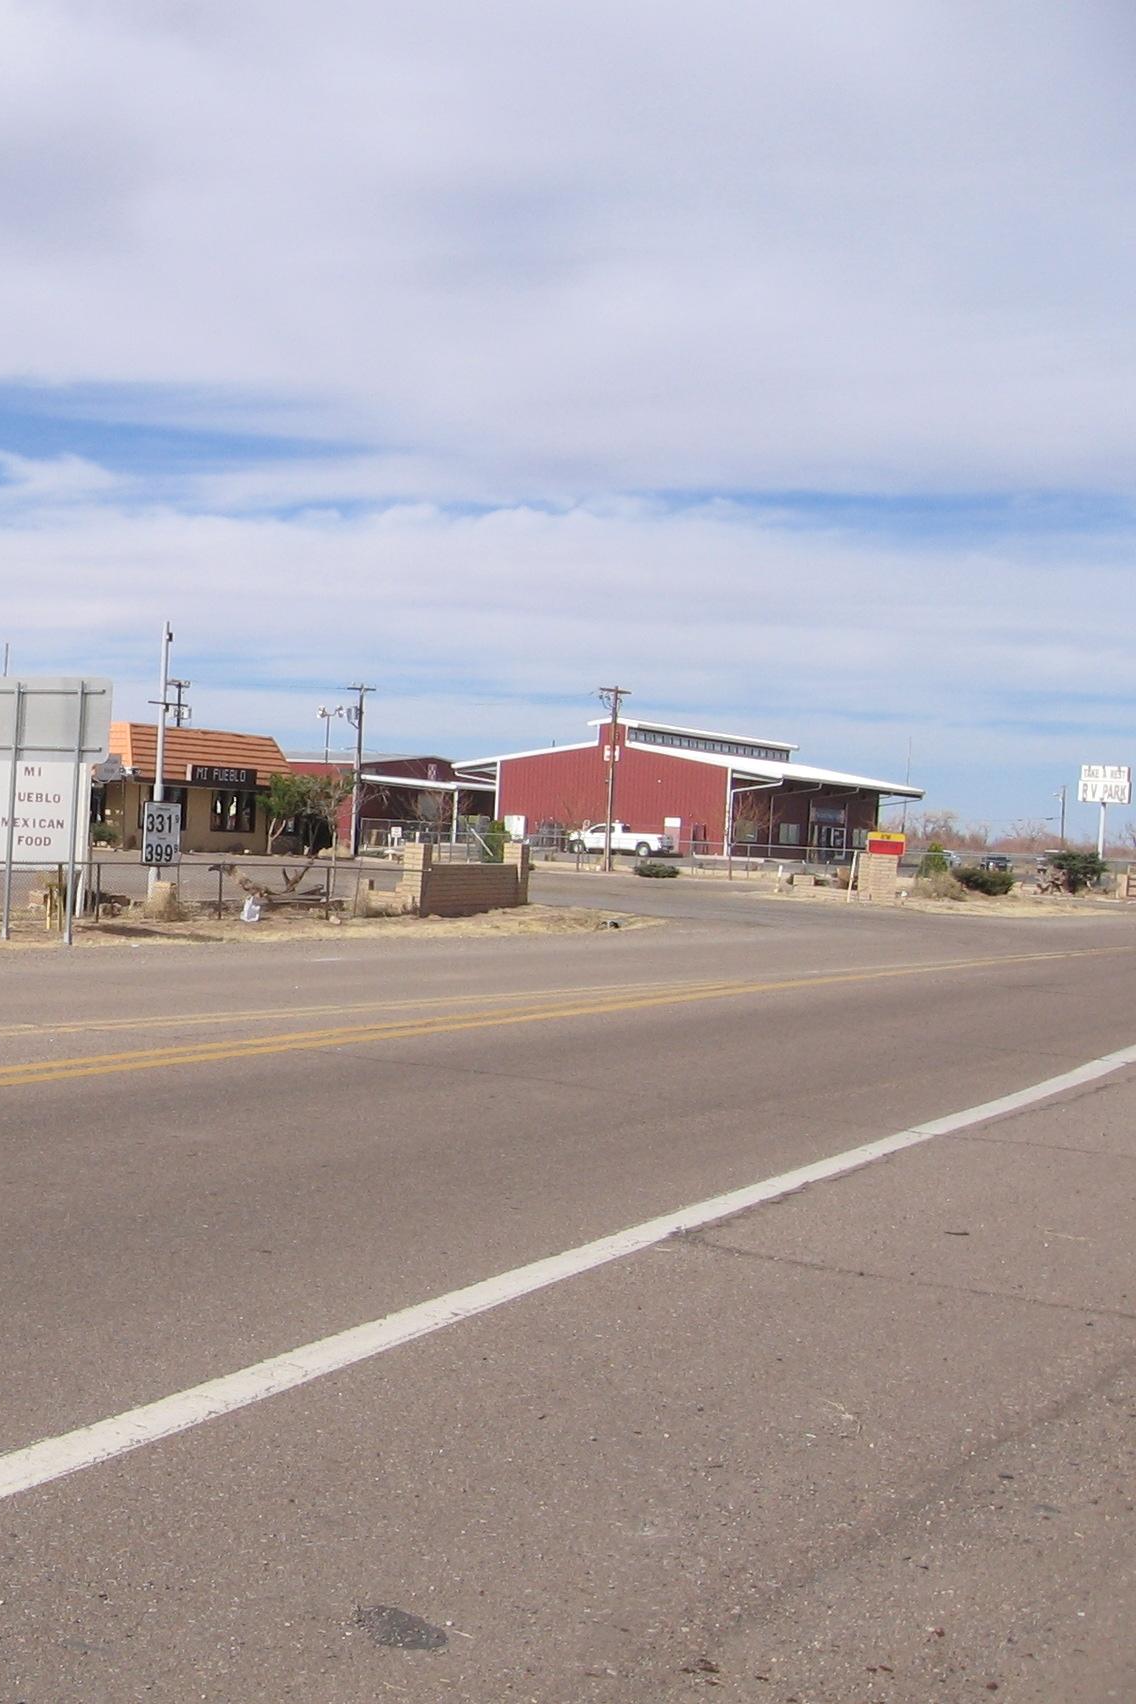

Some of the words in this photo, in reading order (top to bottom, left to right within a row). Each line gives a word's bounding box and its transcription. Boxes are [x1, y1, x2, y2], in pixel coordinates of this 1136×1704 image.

[24, 766, 41, 777] MI
[196, 767, 208, 780] MI
[213, 768, 246, 782] PUEBLO
[1084, 769, 1099, 778] TAKE
[15, 792, 60, 803] UEBLO
[1103, 785, 1126, 800] PARK
[146, 814, 172, 833] 331
[17, 835, 51, 845] FOOD
[145, 844, 173, 862] 399
